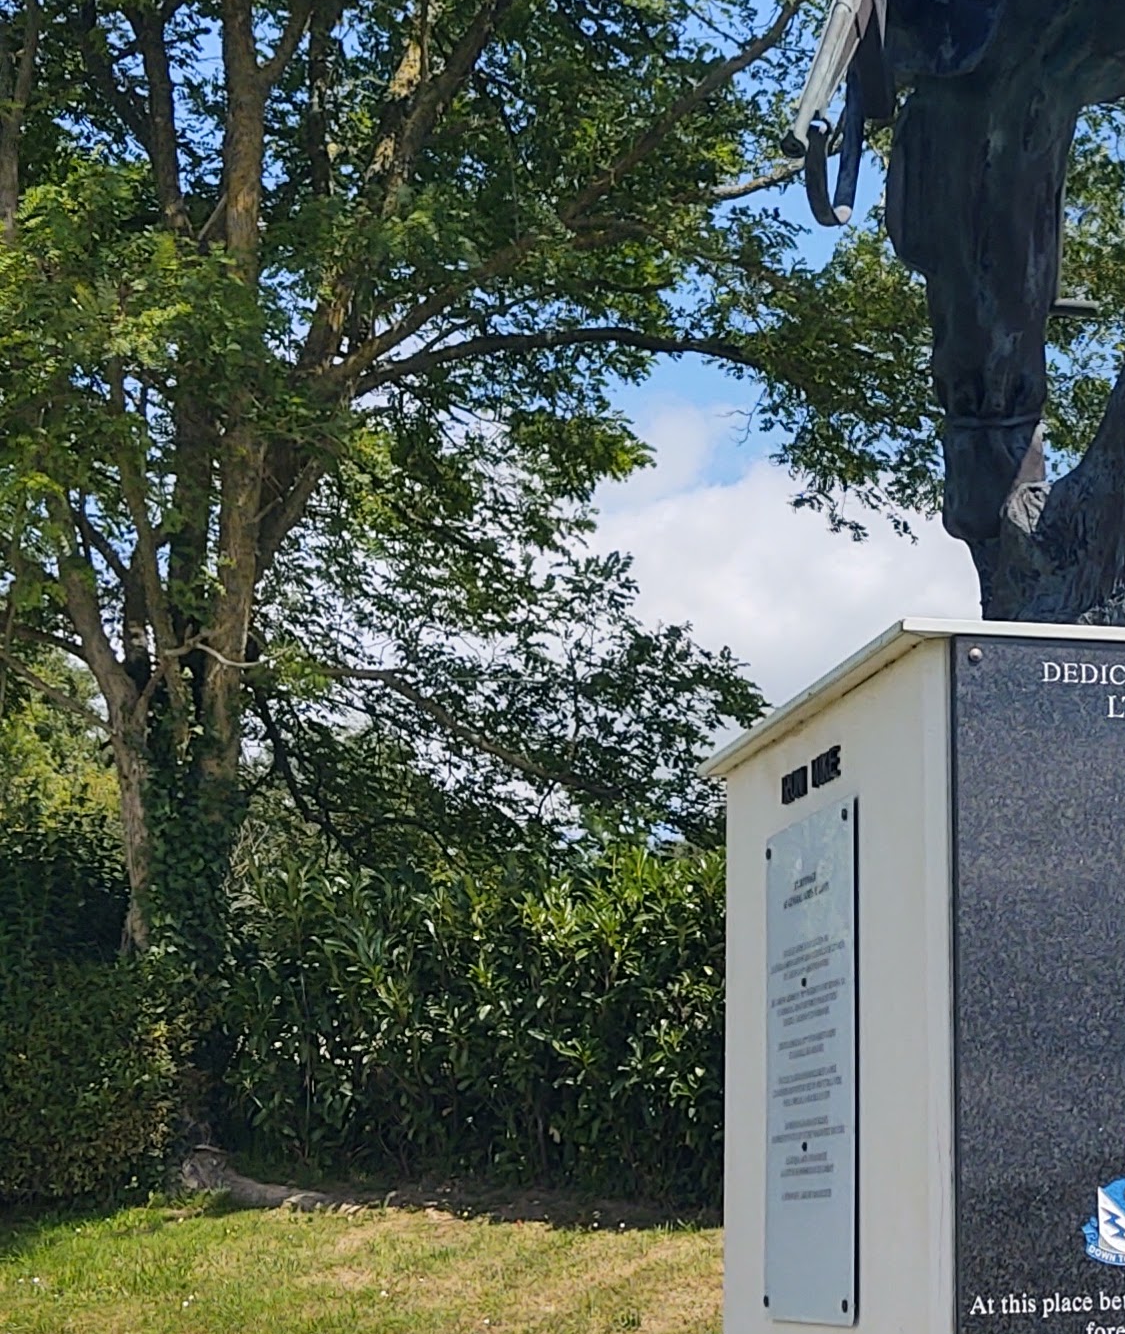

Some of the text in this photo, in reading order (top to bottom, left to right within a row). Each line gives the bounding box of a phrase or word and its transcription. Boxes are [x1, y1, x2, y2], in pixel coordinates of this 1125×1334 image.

[1088, 1244, 1116, 1262] DOWN
[969, 1295, 995, 1316] At
[1000, 1292, 1037, 1315] this
[1042, 1292, 1093, 1319] place
